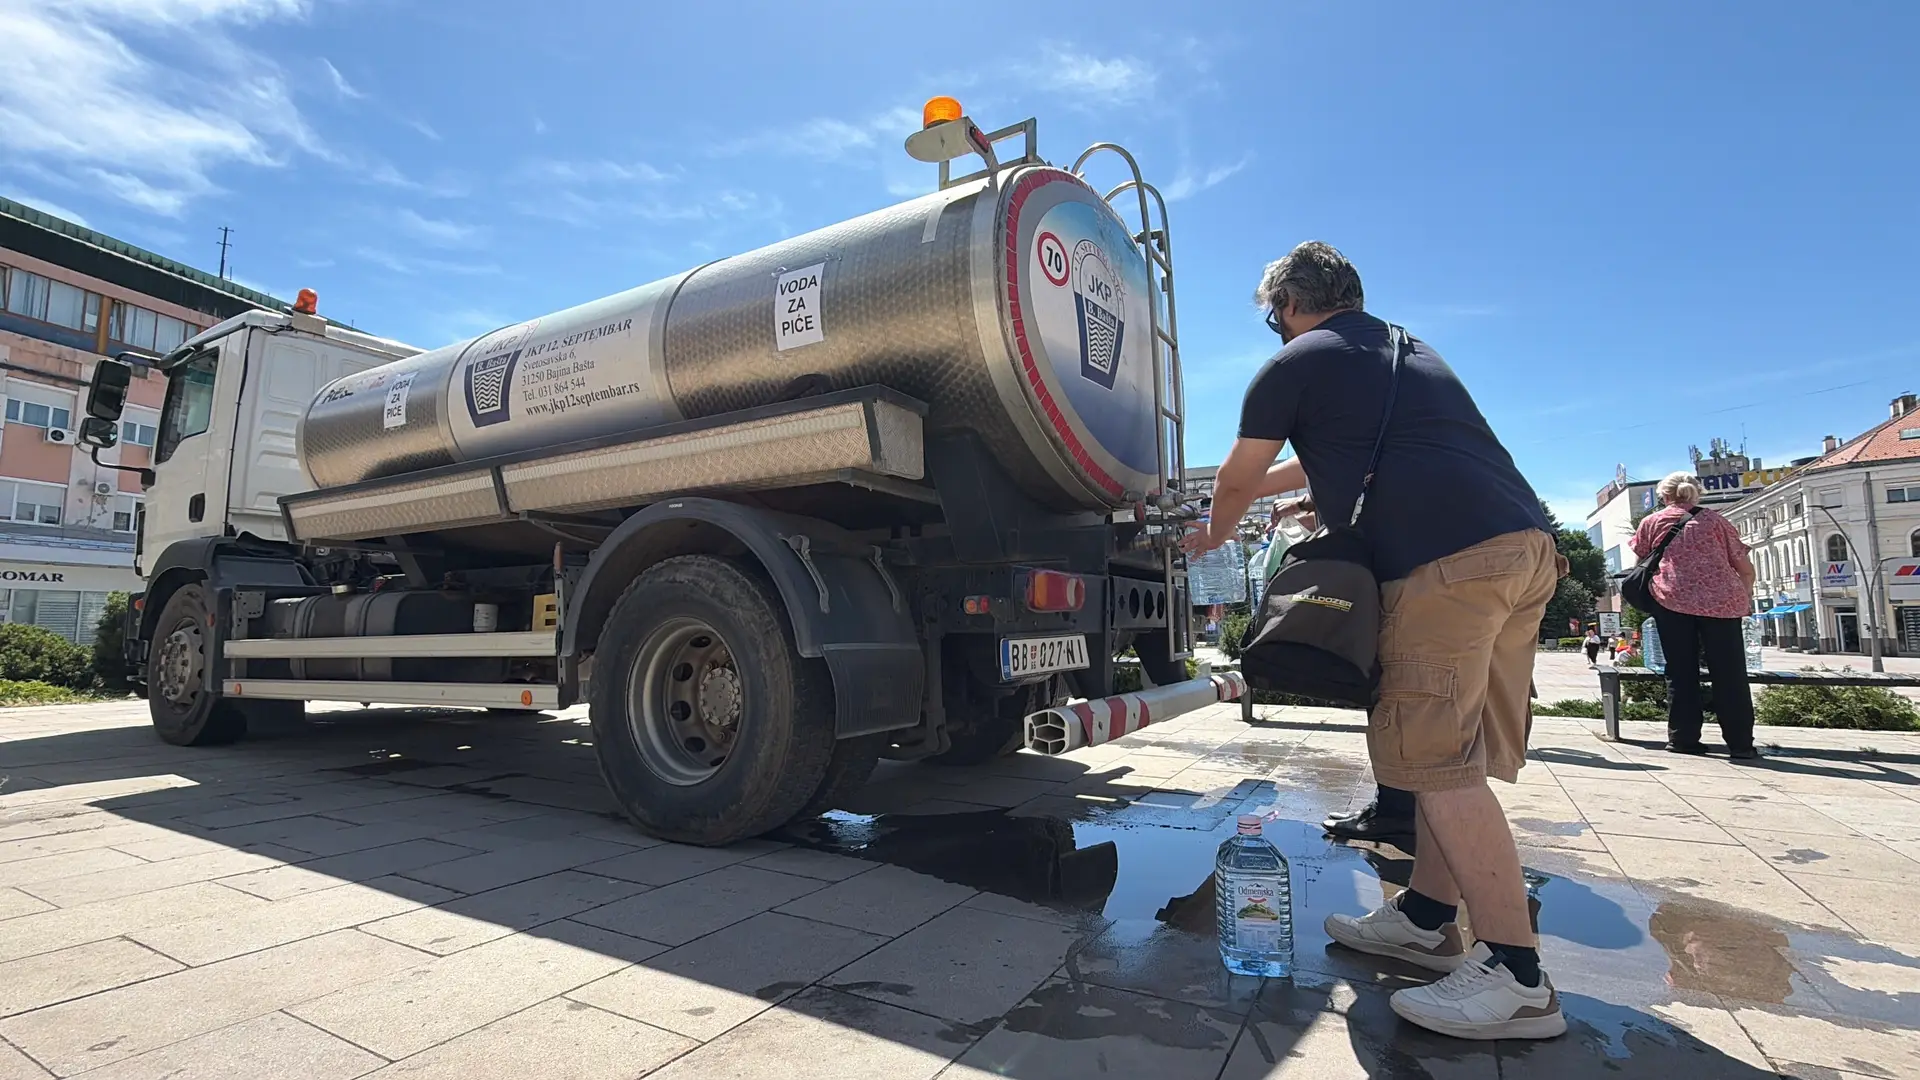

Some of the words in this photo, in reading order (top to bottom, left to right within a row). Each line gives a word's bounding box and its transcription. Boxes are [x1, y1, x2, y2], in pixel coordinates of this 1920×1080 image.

[1046, 245, 1063, 273] 70
[780, 275, 818, 295] VODA
[1088, 274, 1112, 302] JKP
[787, 296, 806, 313] ZA
[1087, 301, 1096, 315] B.
[782, 313, 814, 336] PIĆE
[486, 336, 518, 354] JKP
[525, 344, 546, 358] JKP
[547, 340, 559, 352] 12.
[561, 319, 632, 347] SEPTEMBAR
[522, 351, 568, 372] Svetosavska
[569, 348, 577, 359] 6,
[521, 370, 545, 386] 31250
[546, 366, 571, 381] Bajina
[573, 360, 595, 373] Bašta
[391, 393, 401, 404] ZA
[523, 390, 538, 401] Tel.
[538, 385, 552, 398] 031
[554, 381, 569, 394] 864
[570, 376, 586, 390] 544
[526, 382, 640, 416] www.jkp12septembar.rs
[386, 403, 402, 418] PIĆE
[1703, 473, 1740, 491] AN
[0, 571, 64, 582] OMAR
[1011, 643, 1028, 671] BB
